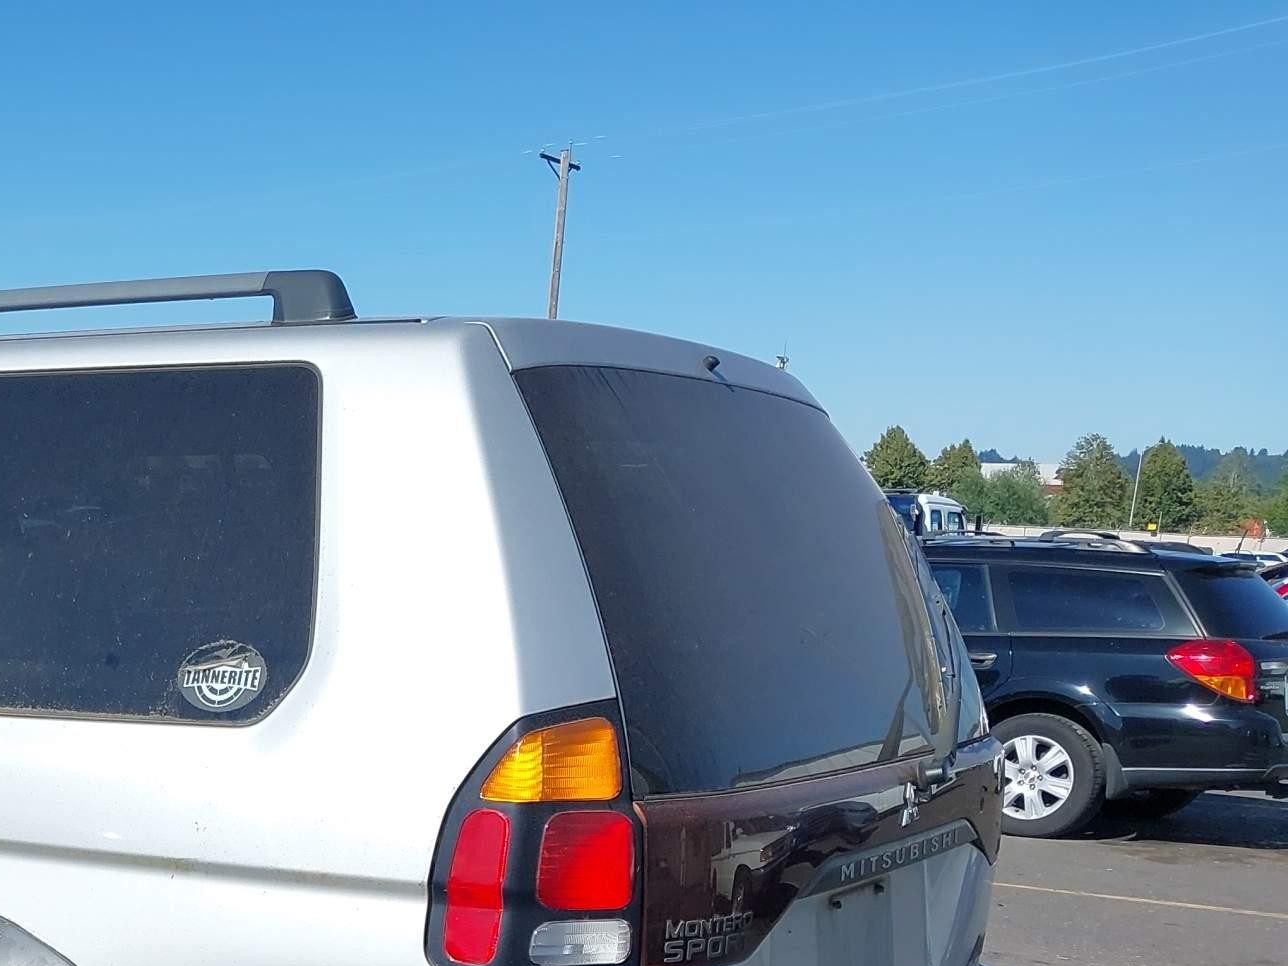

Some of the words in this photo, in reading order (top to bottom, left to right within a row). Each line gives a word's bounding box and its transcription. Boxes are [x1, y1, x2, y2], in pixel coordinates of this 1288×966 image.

[185, 669, 260, 689] TANNERITE
[840, 829, 960, 881] MITSUBISHI
[665, 911, 753, 939] MONTERO
